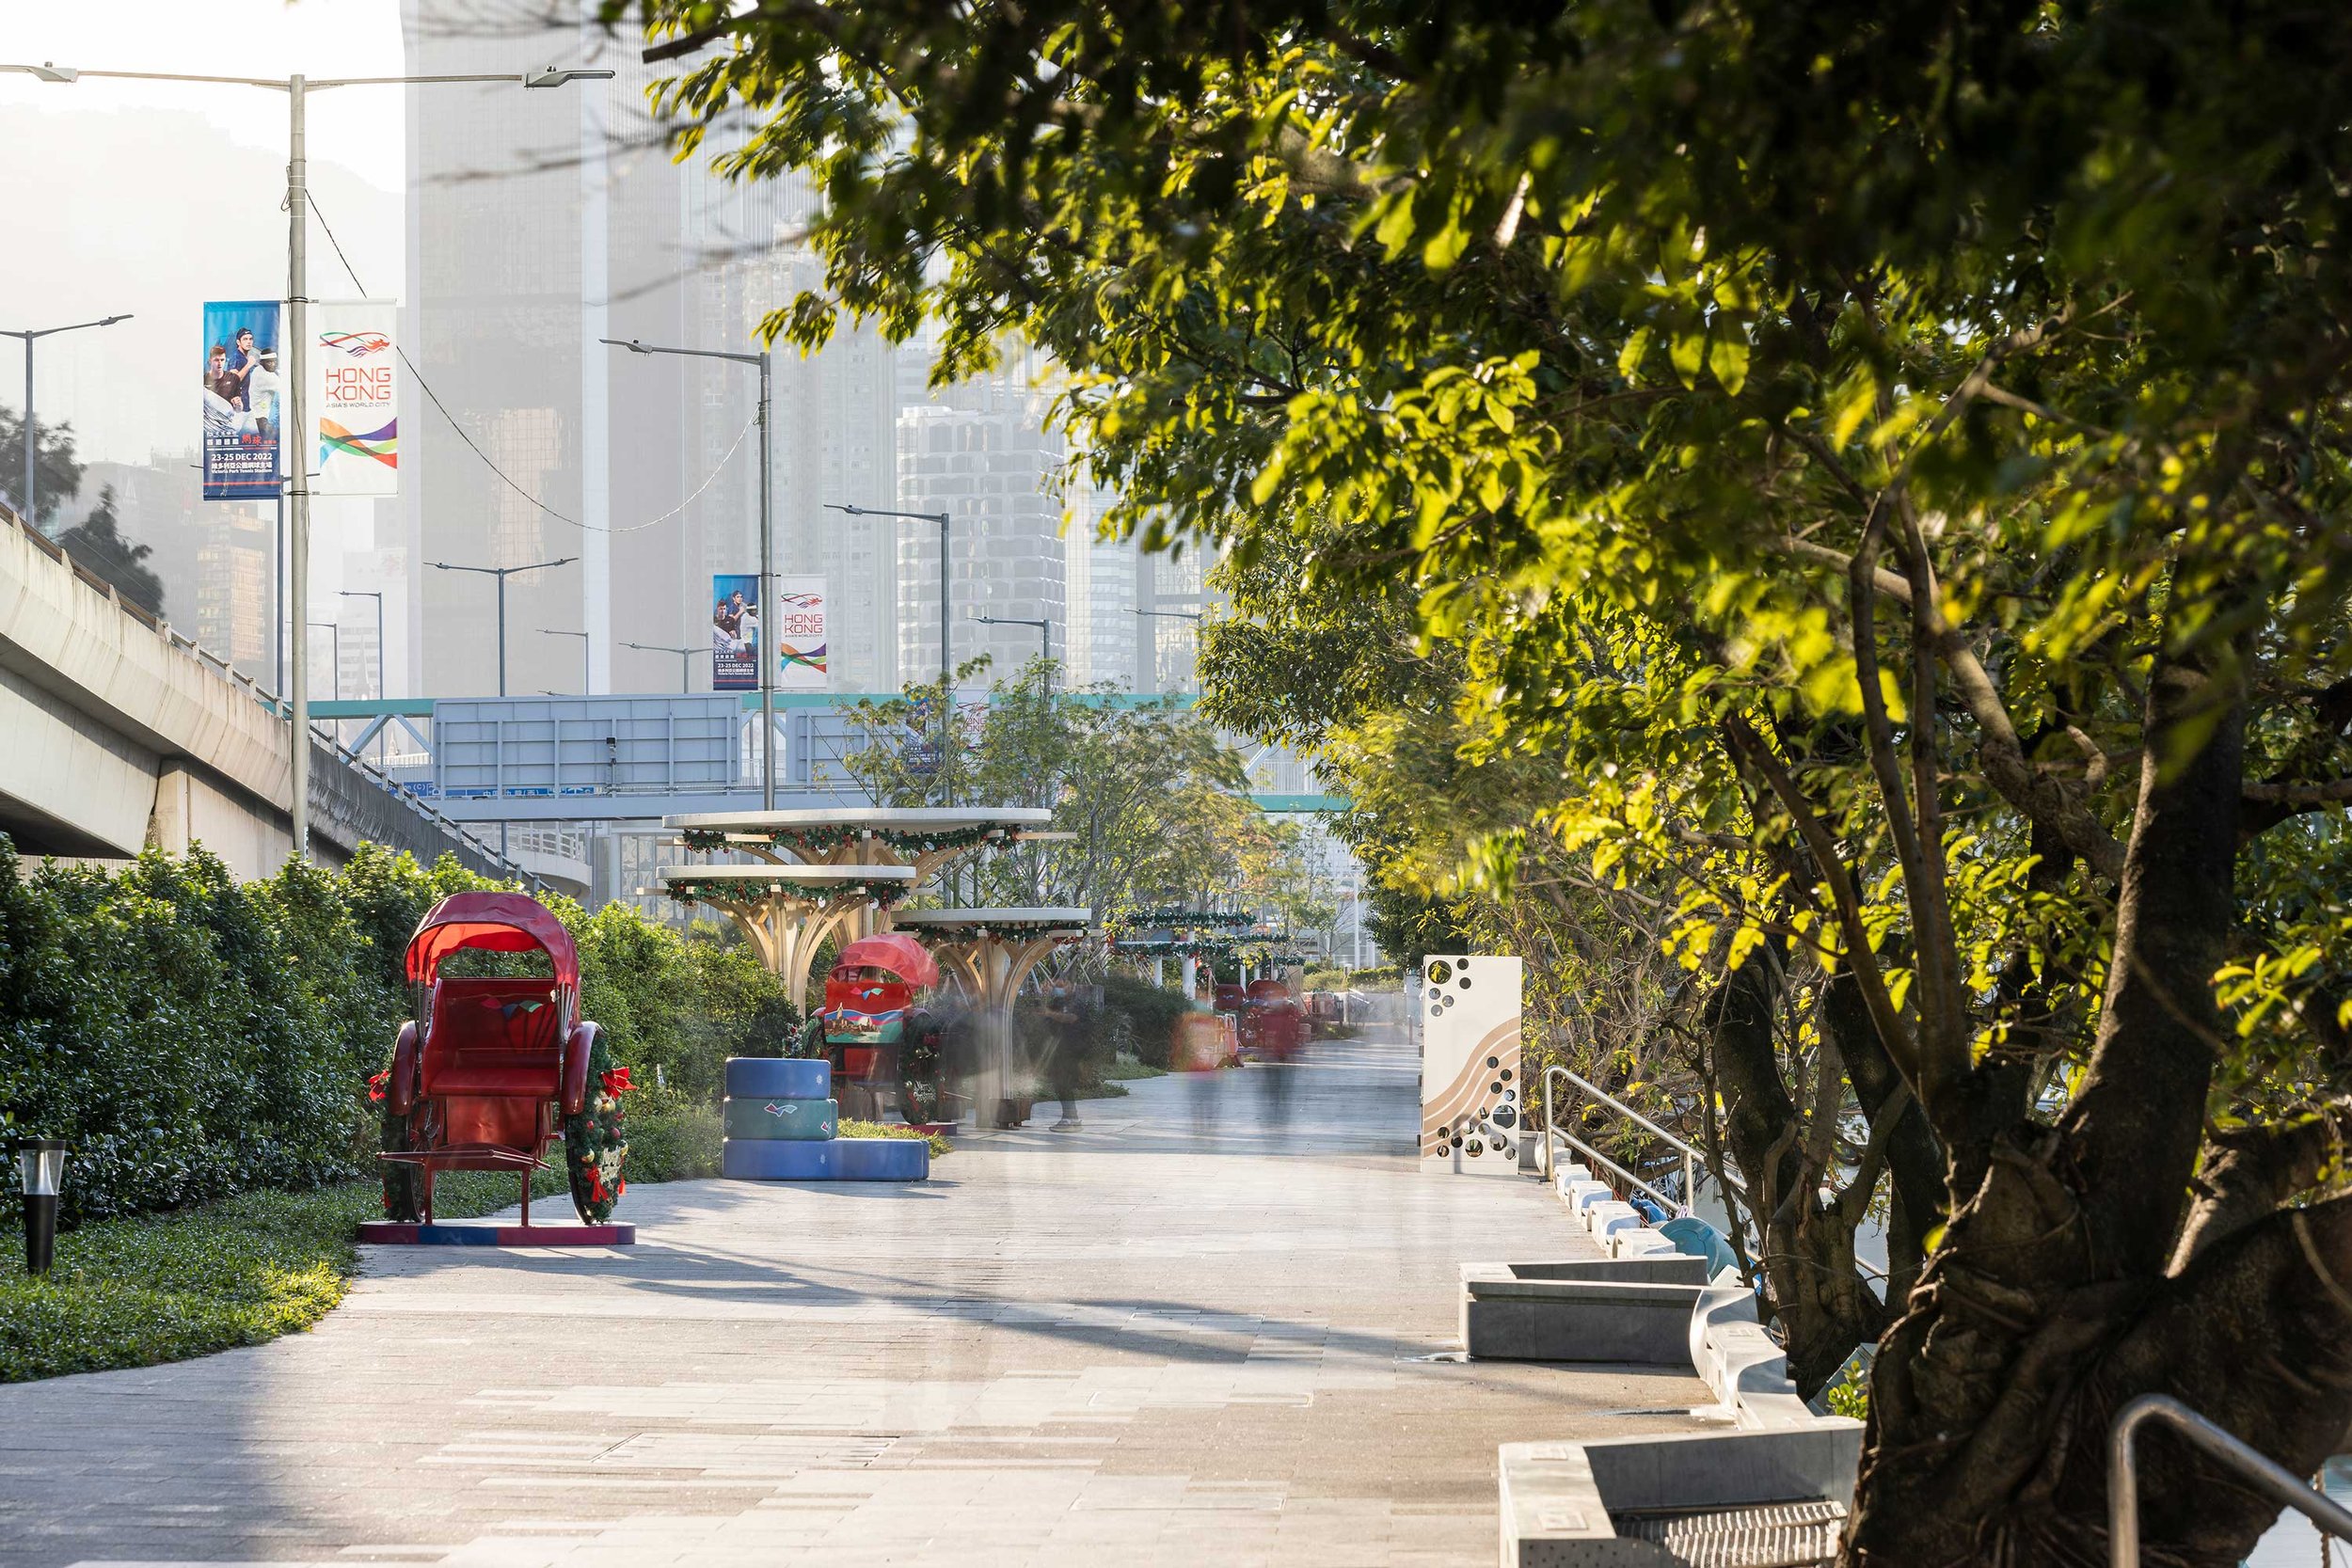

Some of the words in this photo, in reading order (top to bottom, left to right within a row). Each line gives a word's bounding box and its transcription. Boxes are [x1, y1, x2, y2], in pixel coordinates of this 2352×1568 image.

[326, 367, 391, 384] HONG
[326, 385, 391, 401] KONG
[784, 613, 823, 624] HONG
[784, 624, 823, 634] KONG
